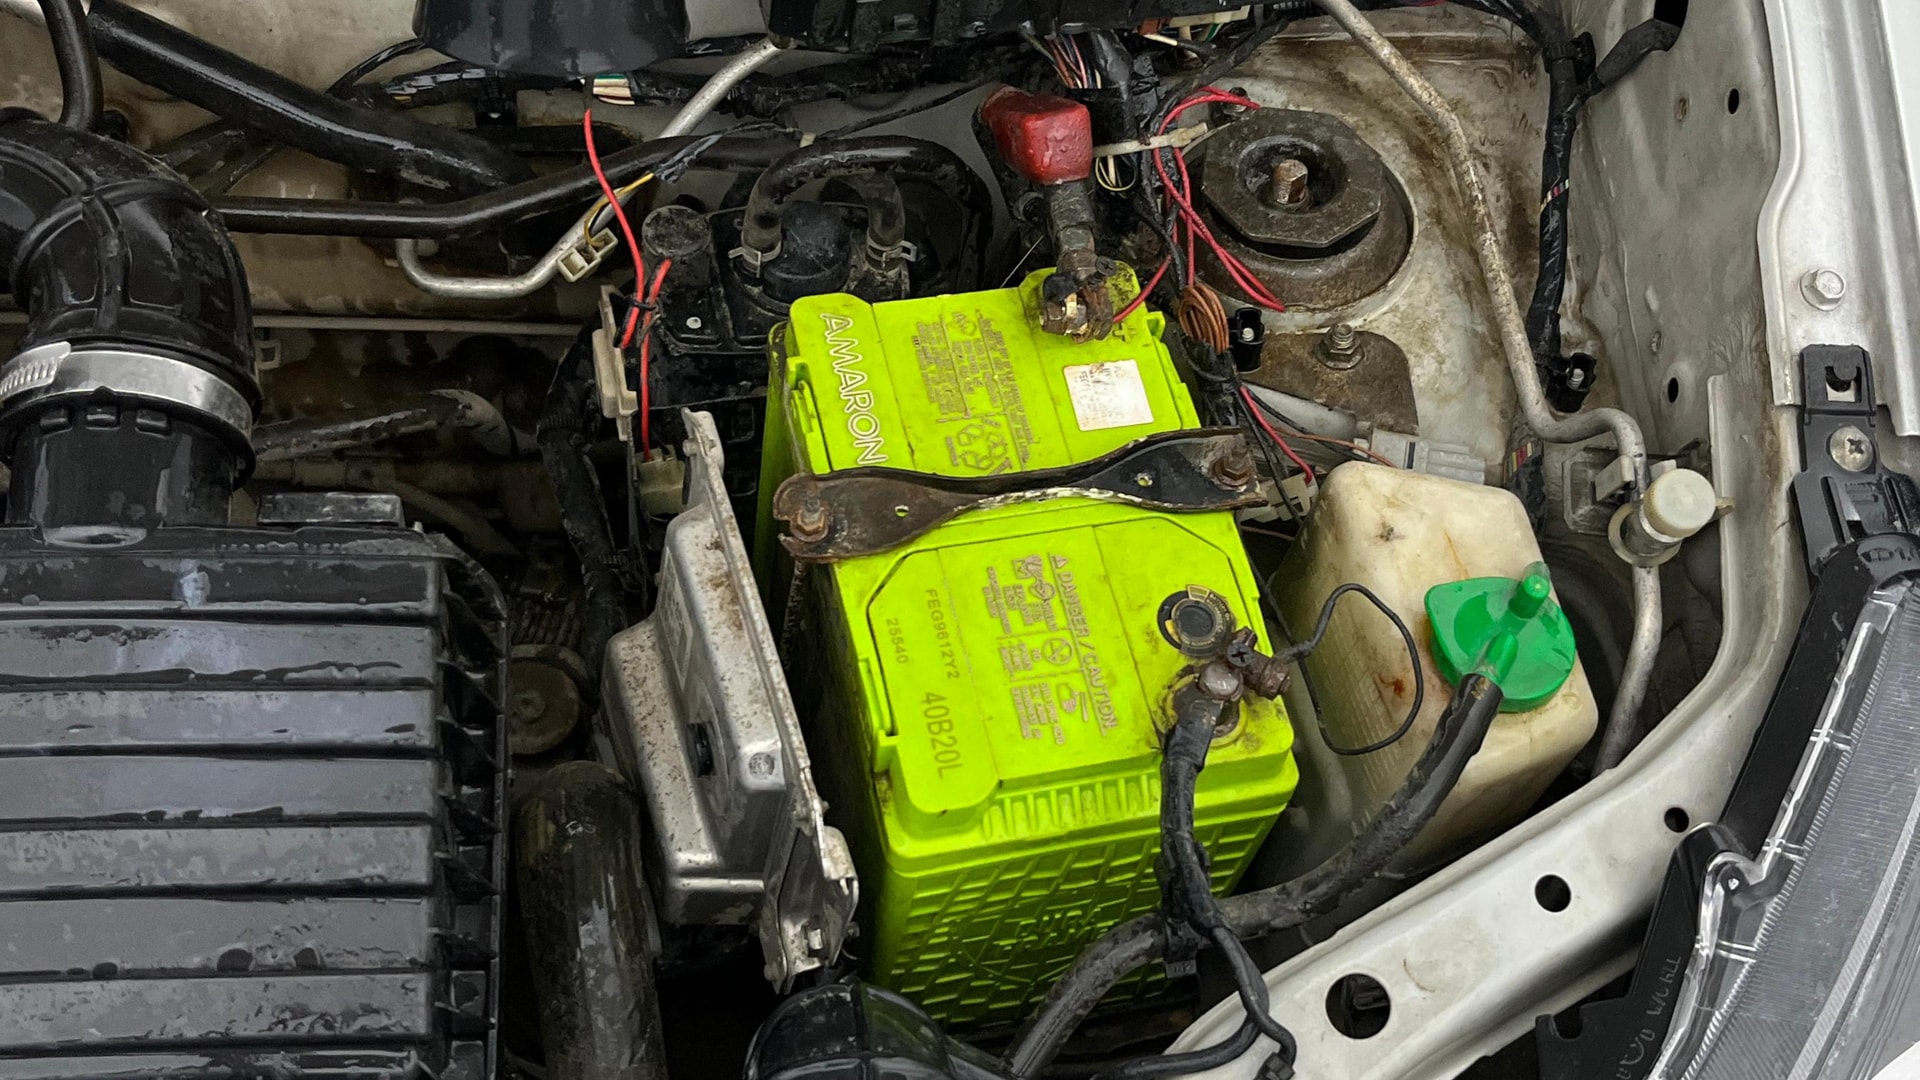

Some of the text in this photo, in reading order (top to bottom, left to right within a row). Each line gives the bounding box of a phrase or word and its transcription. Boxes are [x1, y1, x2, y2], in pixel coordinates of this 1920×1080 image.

[821, 313, 888, 465] AMARON
[886, 617, 909, 664] 25540
[1056, 571, 1090, 637] DANGER
[1082, 652, 1119, 729] CAUTION
[921, 691, 963, 779] 40B20L
